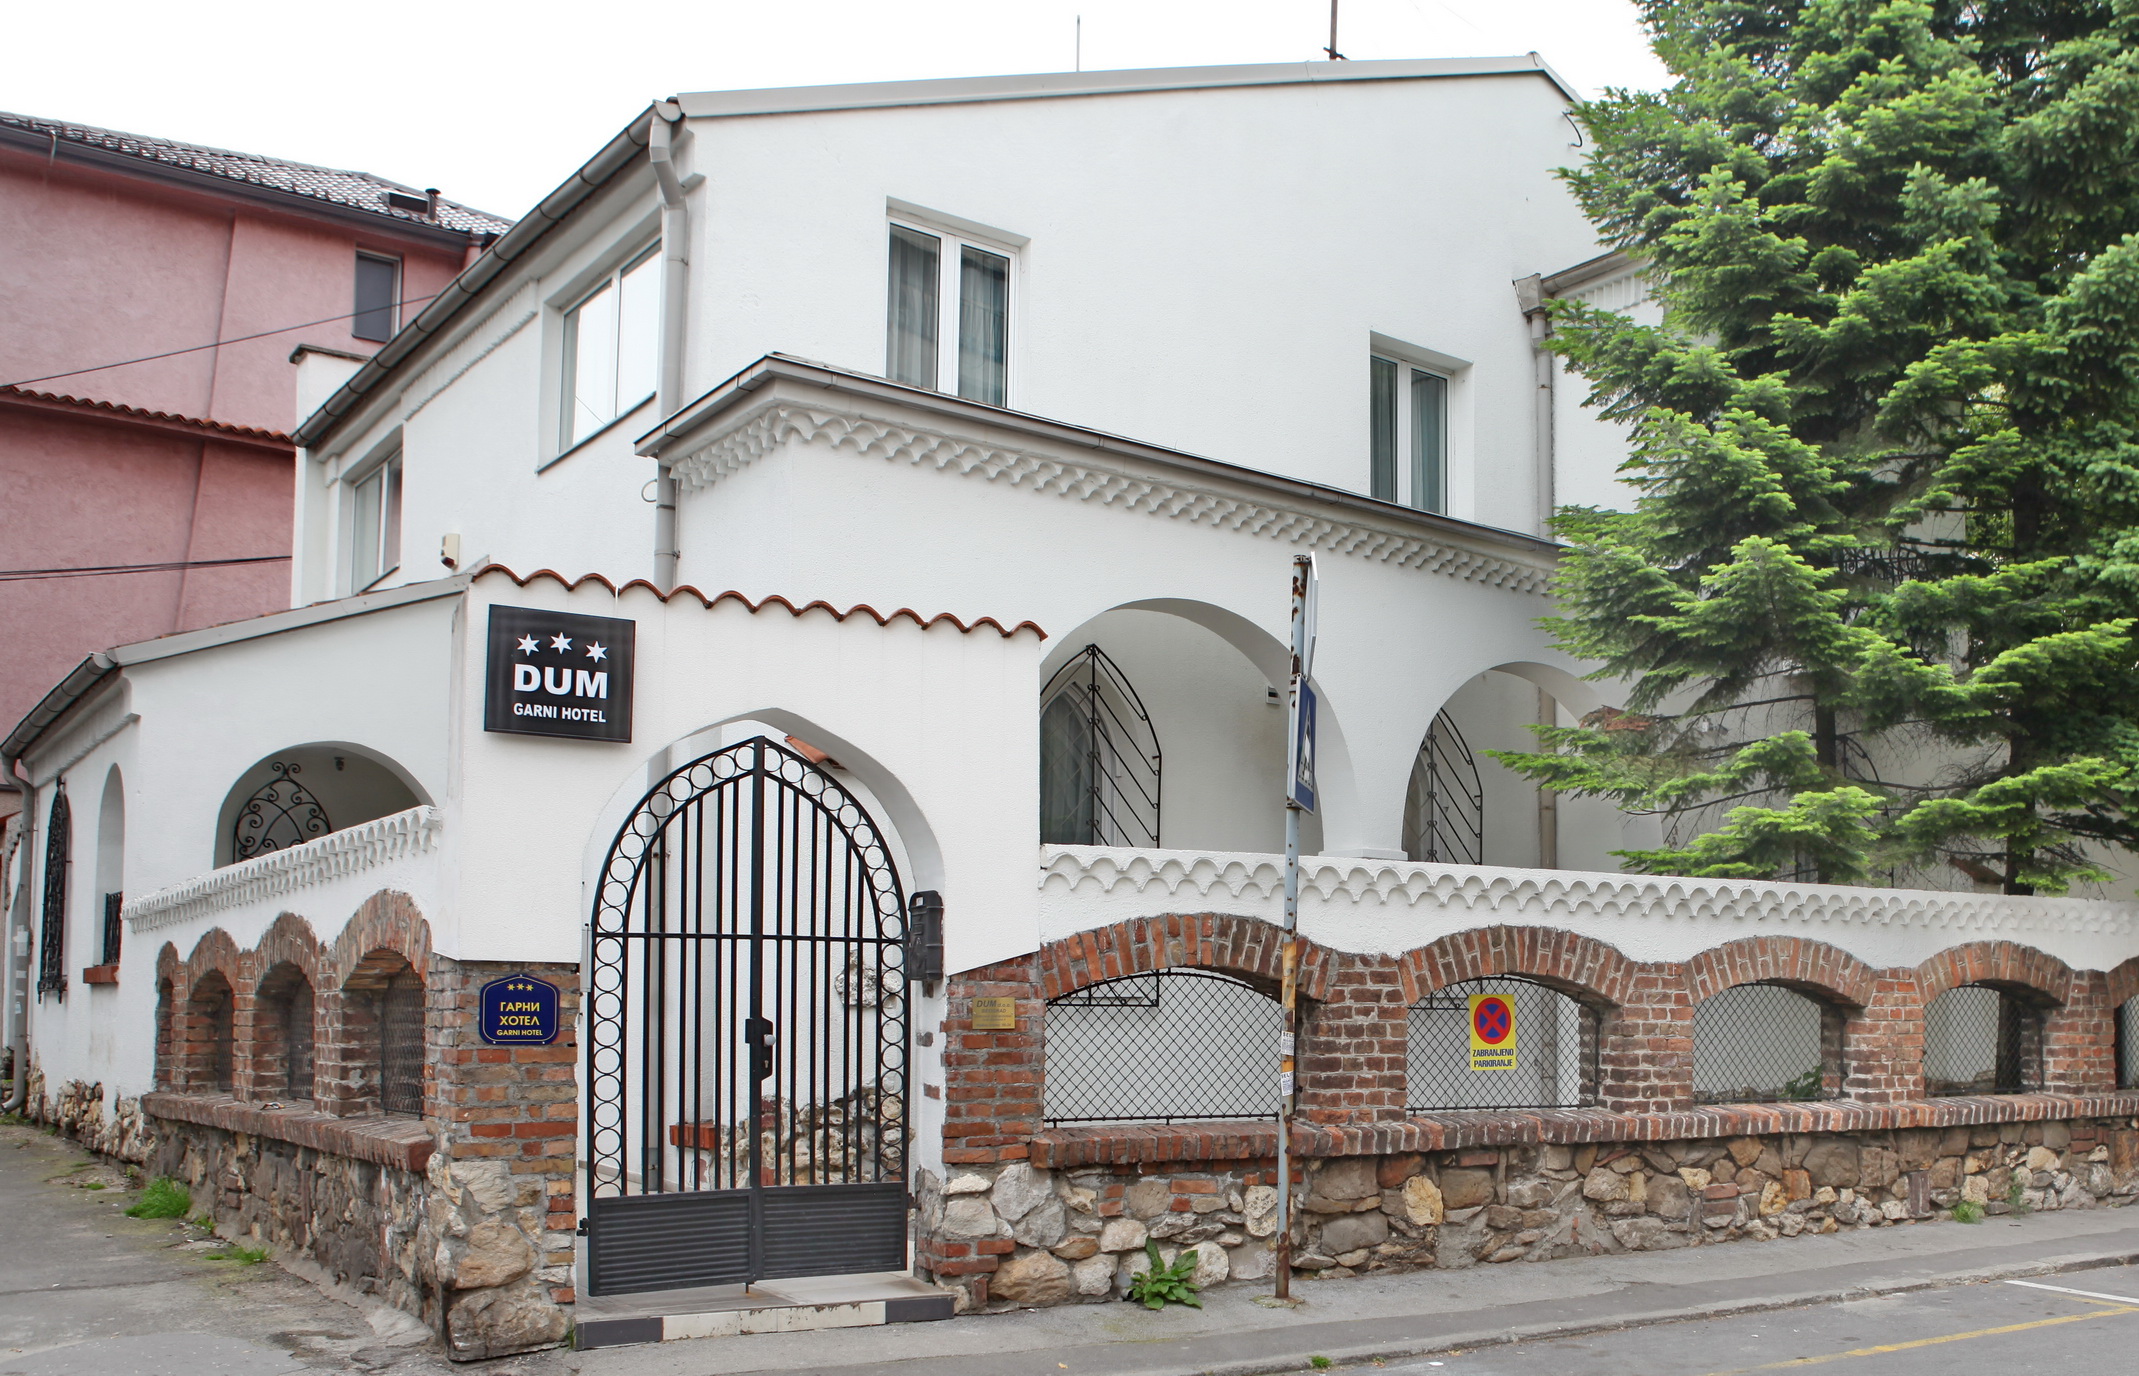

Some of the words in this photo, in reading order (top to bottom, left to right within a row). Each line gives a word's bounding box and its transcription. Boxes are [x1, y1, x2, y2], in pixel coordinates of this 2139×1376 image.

[513, 663, 608, 699] DUM
[513, 702, 557, 719] GARNI
[561, 707, 607, 723] HOTEL
[500, 1002, 540, 1012] ГАРНИ
[976, 1000, 997, 1008] DUM
[499, 1015, 540, 1026] ХОТЕЛ
[1472, 1048, 1514, 1057] ZABRANJENO
[1473, 1059, 1513, 1067] PARKIRANJE
